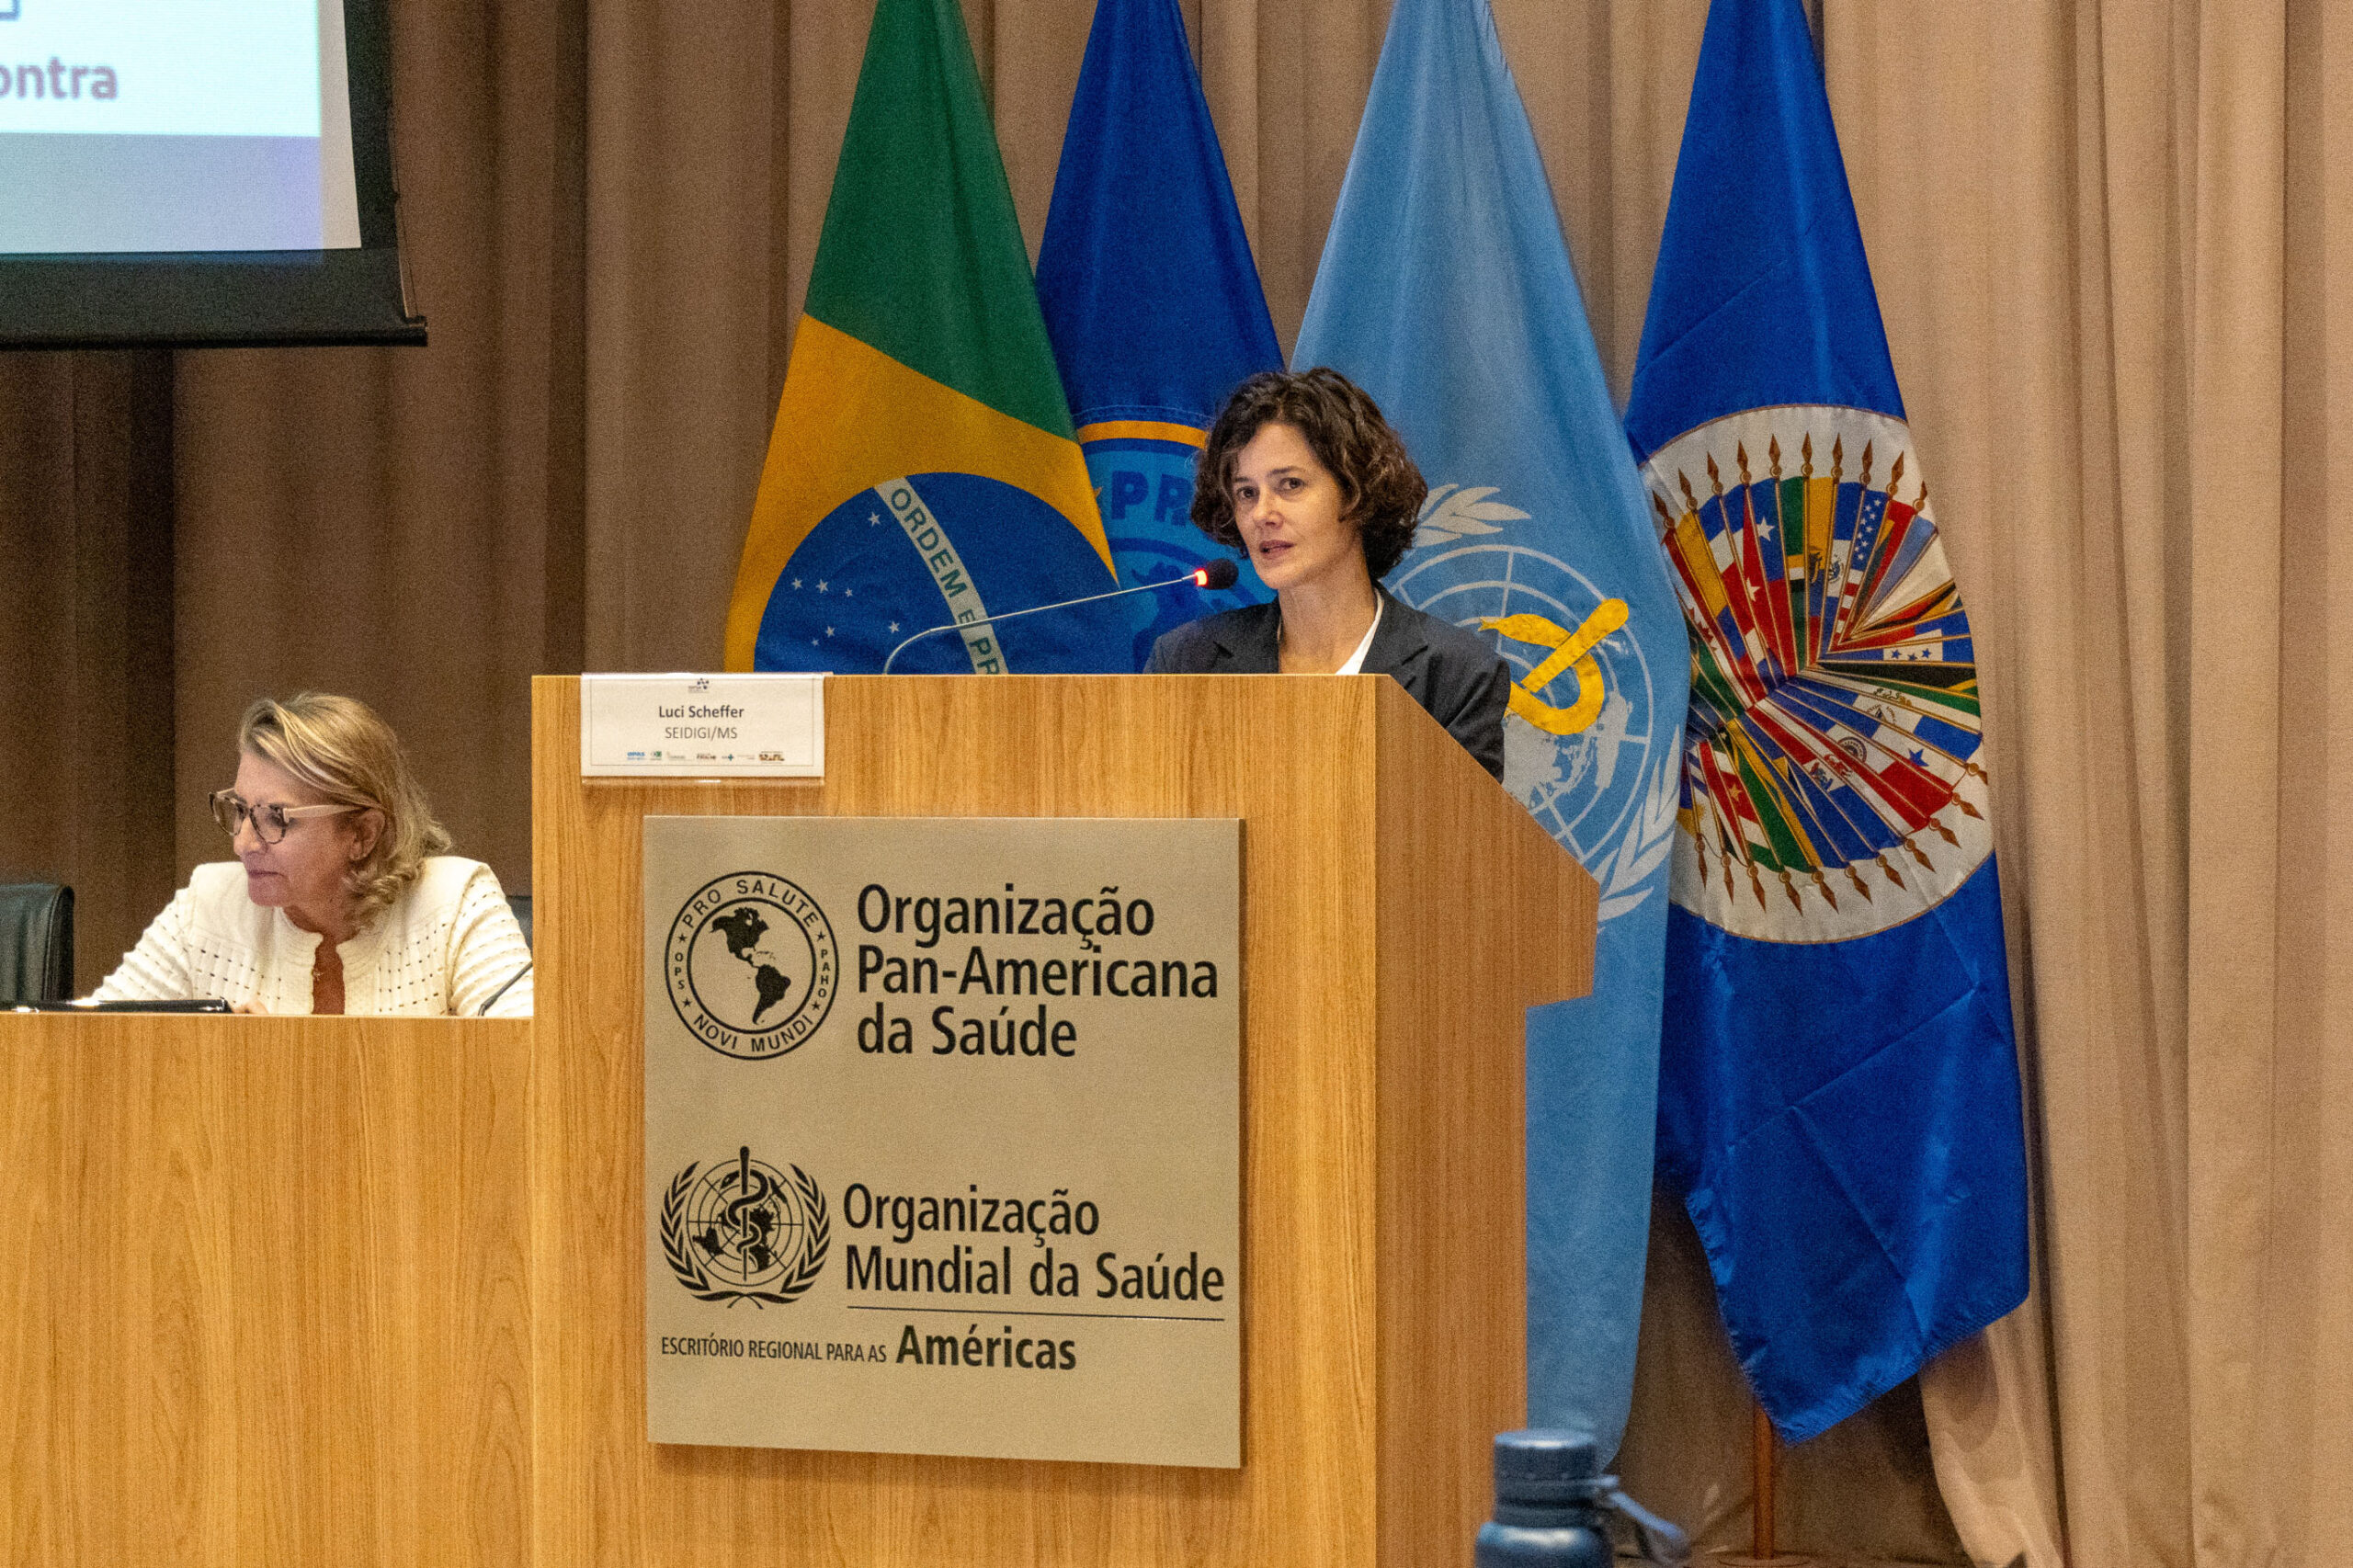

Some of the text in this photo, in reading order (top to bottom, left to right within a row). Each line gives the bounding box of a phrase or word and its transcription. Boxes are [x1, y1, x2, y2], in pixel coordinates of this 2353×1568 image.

[1111, 471, 1193, 527] PR
[891, 488, 968, 597] ORDEM
[658, 704, 745, 718] Luci Scheffer
[665, 726, 738, 741] SEIDIGI/MS
[683, 880, 819, 928] PRO SALUTE
[858, 883, 1154, 950] Organização
[675, 952, 686, 990] OPS
[818, 949, 831, 998] PAHO
[858, 944, 1218, 998] Pan-Americana
[693, 1014, 814, 1052] NOVI MUNDI
[858, 1002, 1077, 1057] da Saúde
[844, 1183, 1100, 1247] Organização
[846, 1244, 1225, 1302] Mundial da Saúde
[661, 1324, 1076, 1370] ESCRITÓRIO REGIONAL PARA AS Américas
